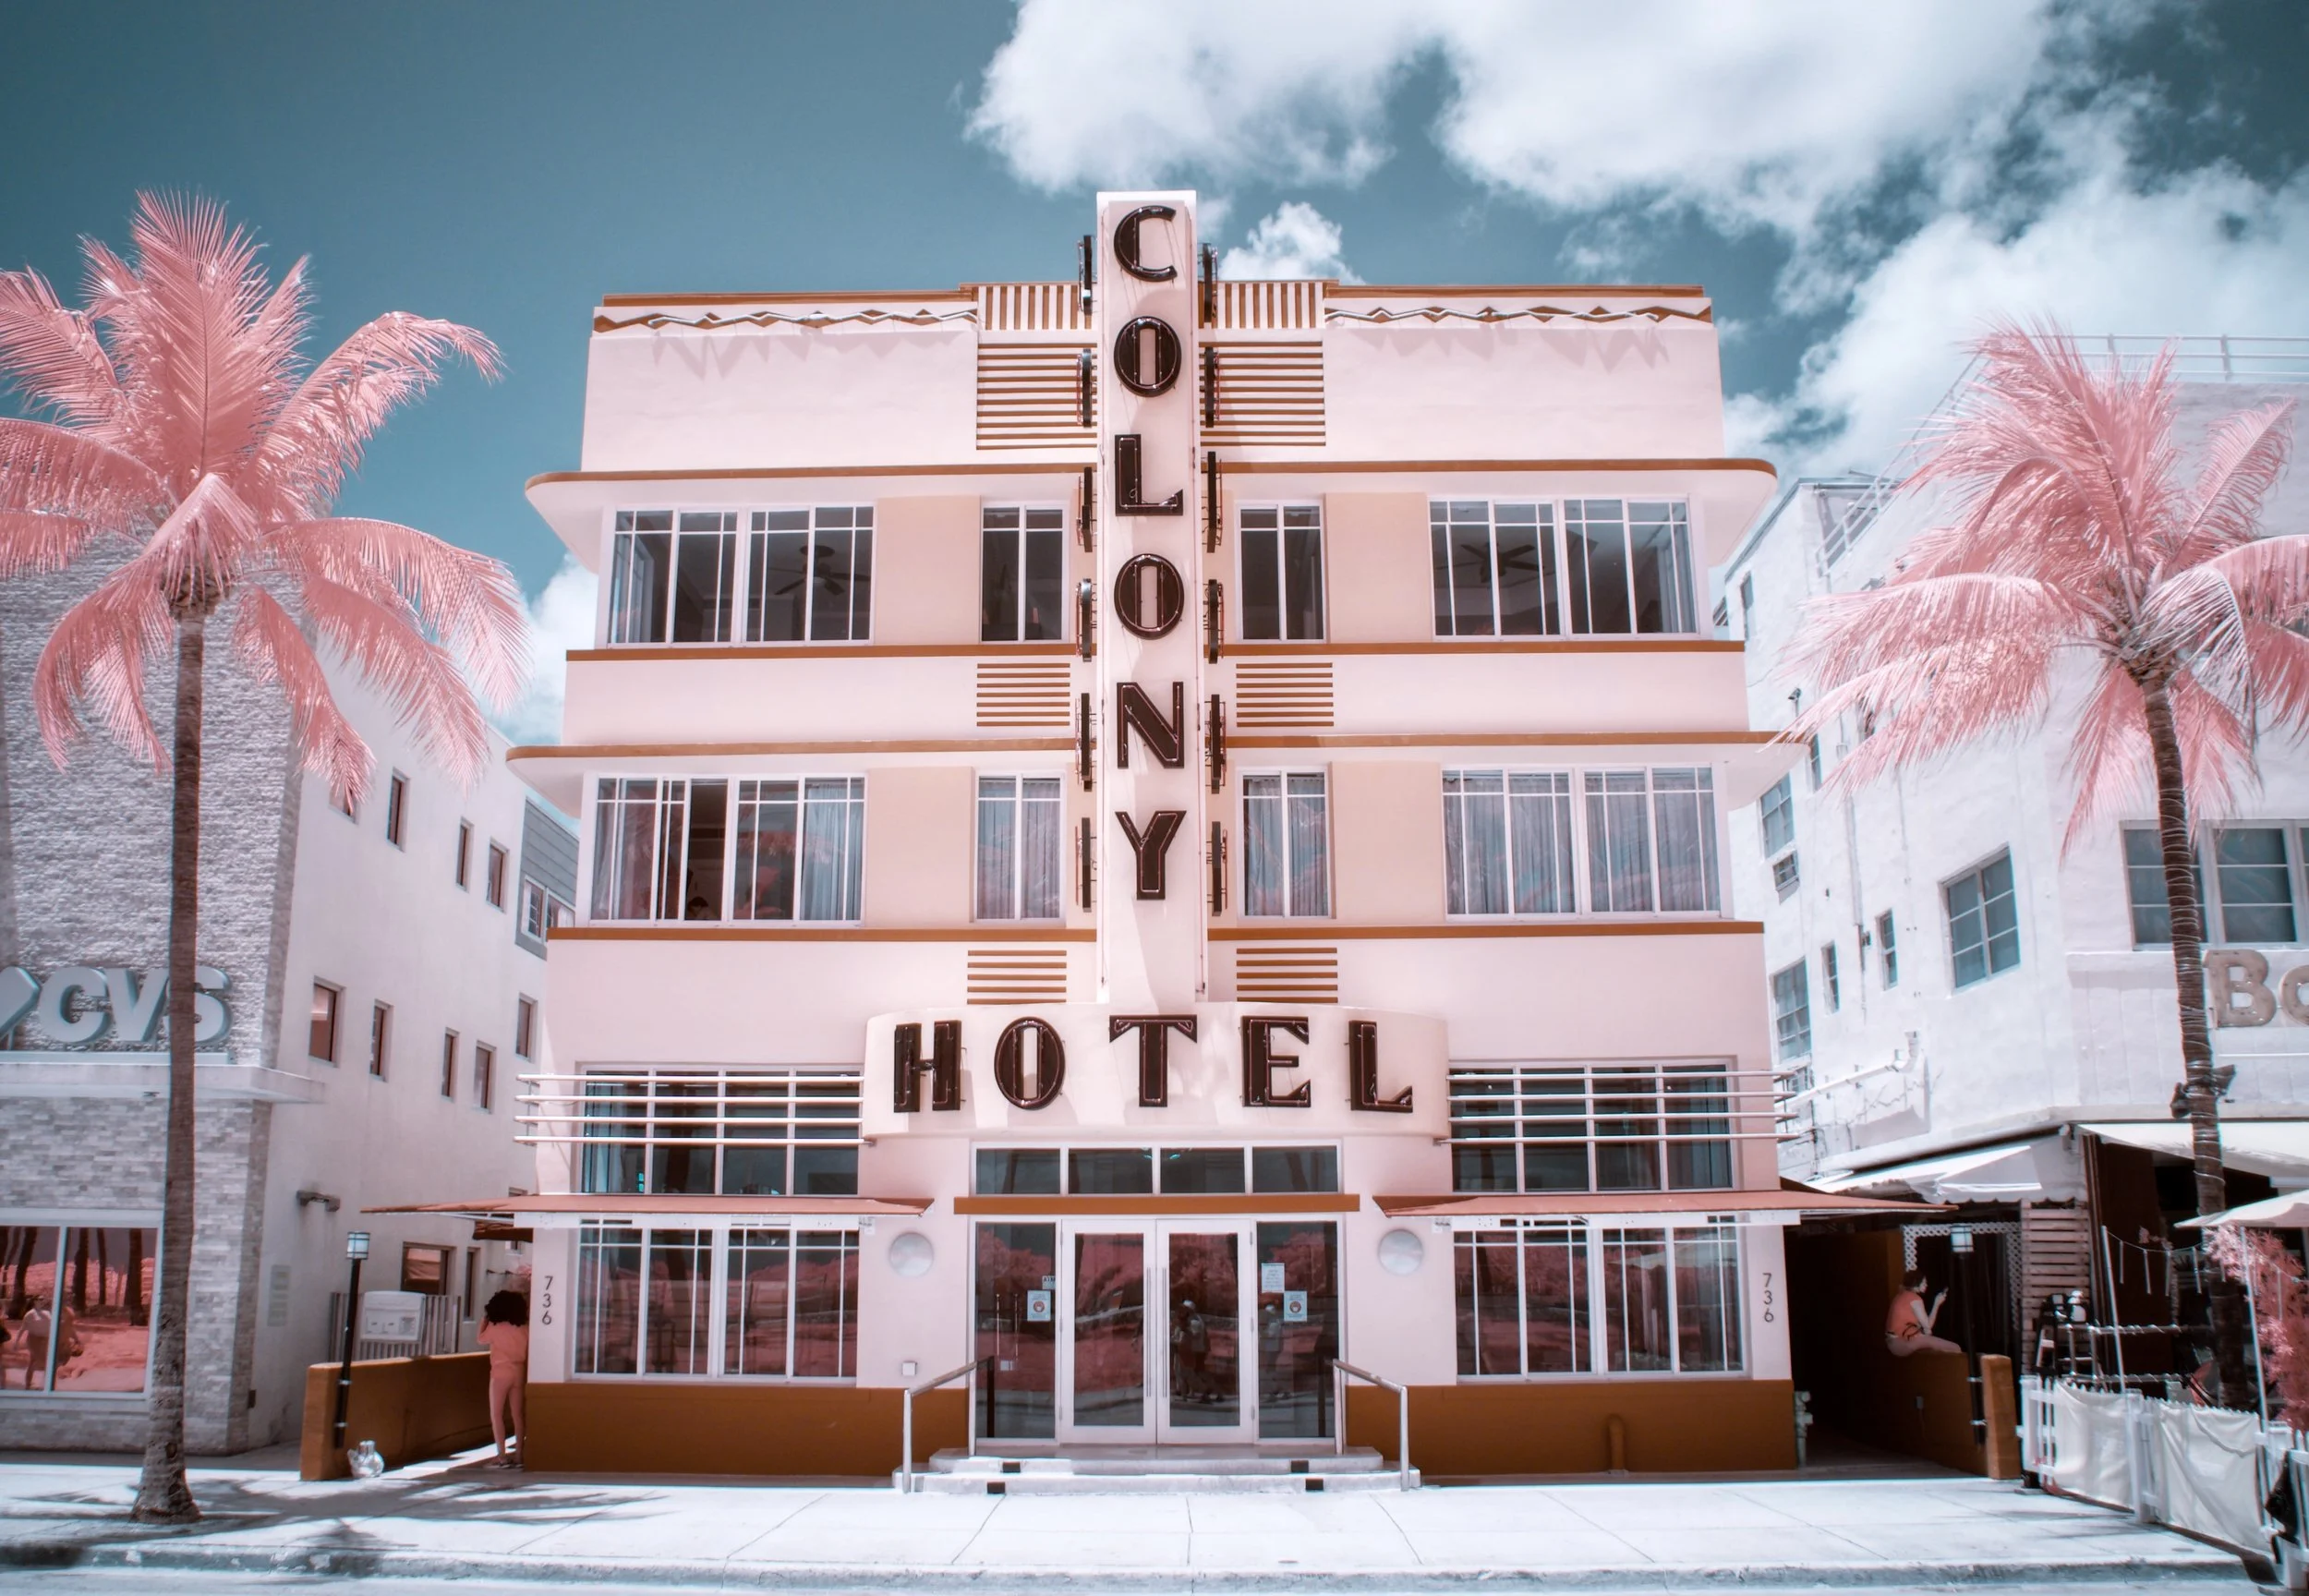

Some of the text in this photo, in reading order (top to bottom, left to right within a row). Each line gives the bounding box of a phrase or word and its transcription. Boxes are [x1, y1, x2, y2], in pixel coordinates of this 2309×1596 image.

[1113, 205, 1187, 901] COLONY
[38, 966, 232, 1044] CVS
[893, 1014, 1414, 1114] HOTEL
[541, 1275, 554, 1325] 736
[1762, 1272, 1774, 1324] 736
